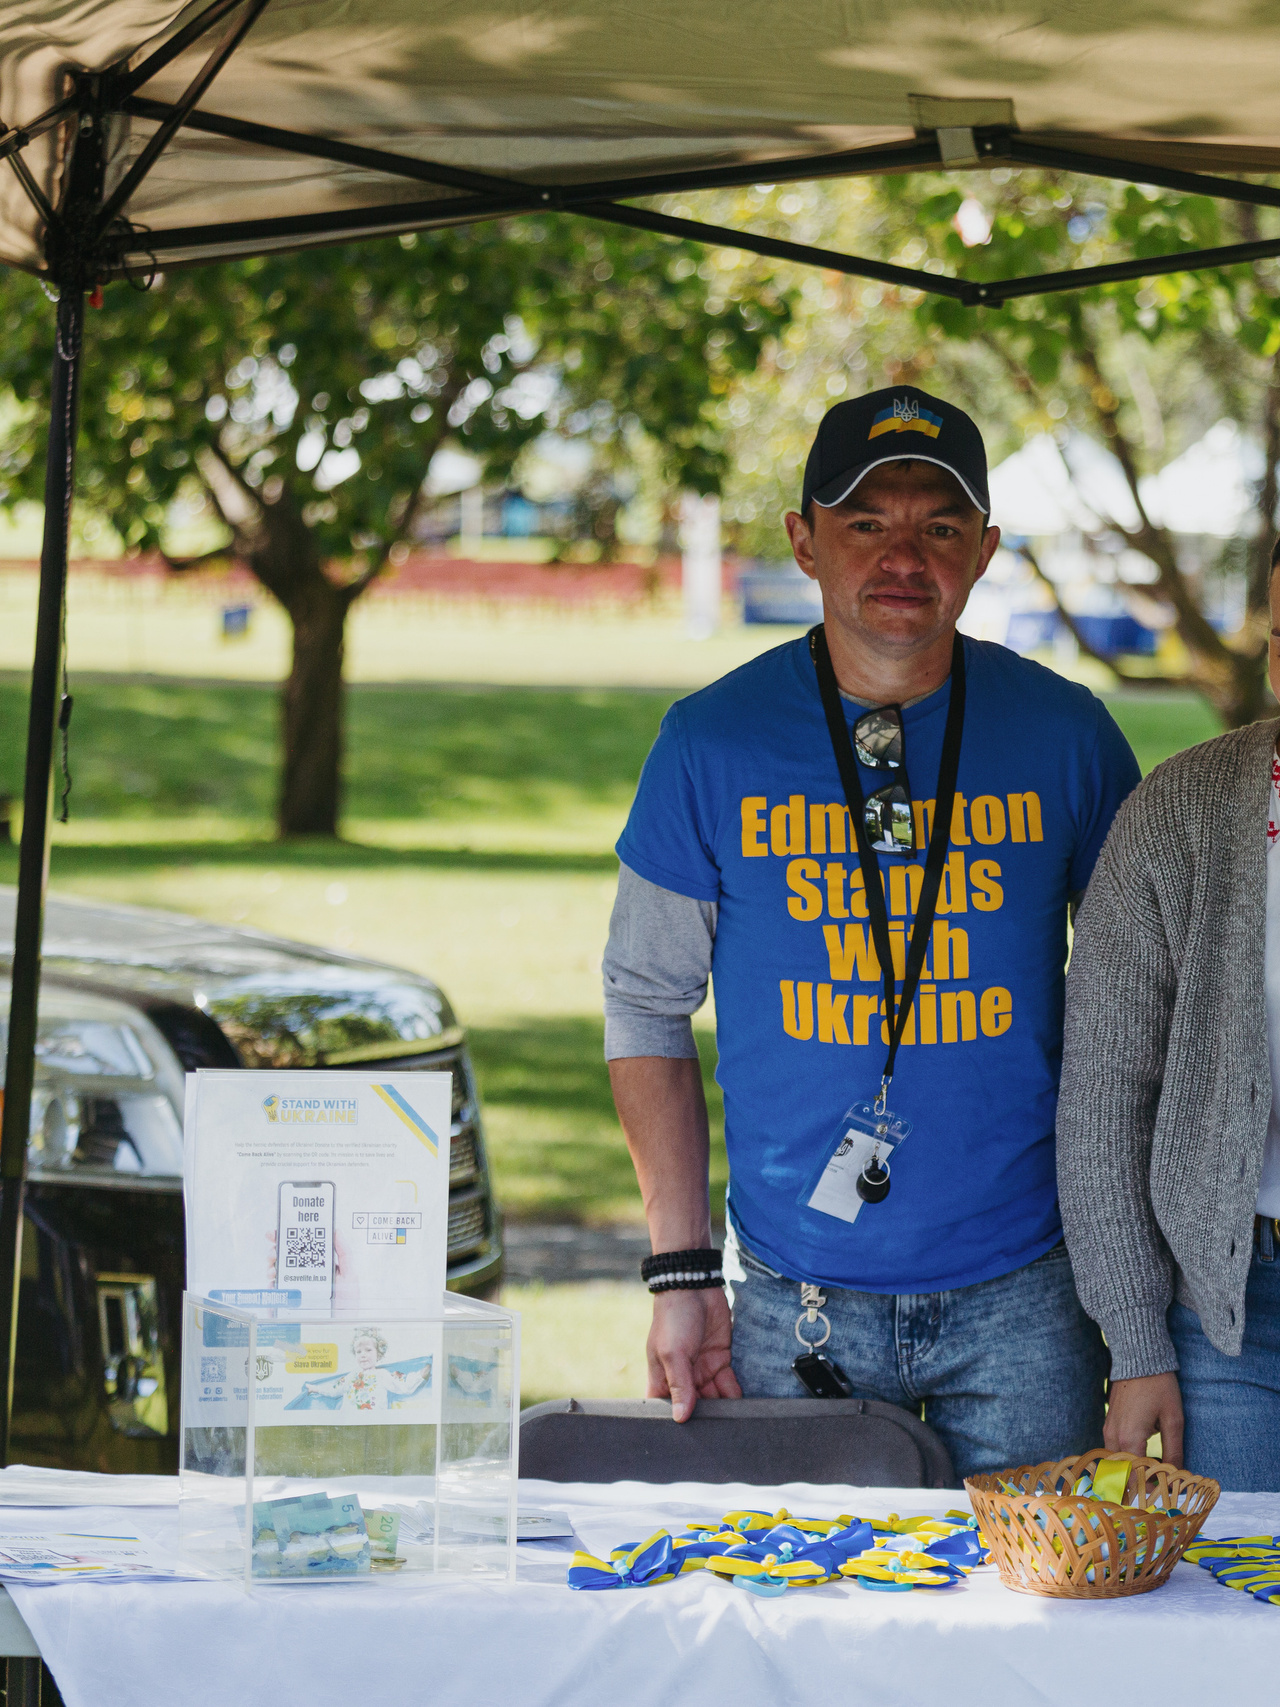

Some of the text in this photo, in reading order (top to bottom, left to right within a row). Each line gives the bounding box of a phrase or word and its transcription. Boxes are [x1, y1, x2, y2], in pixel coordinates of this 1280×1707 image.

[741, 791, 1044, 857] Edmnton
[282, 1100, 357, 1109] STAND WITH
[281, 1110, 356, 1123] UKRAINE
[293, 1196, 325, 1207] Donate
[298, 1211, 319, 1222] here
[372, 1217, 416, 1225] COME BACK
[372, 1232, 393, 1240] ALIVE
[341, 1504, 354, 1513] 5
[380, 1515, 394, 1533] 20
